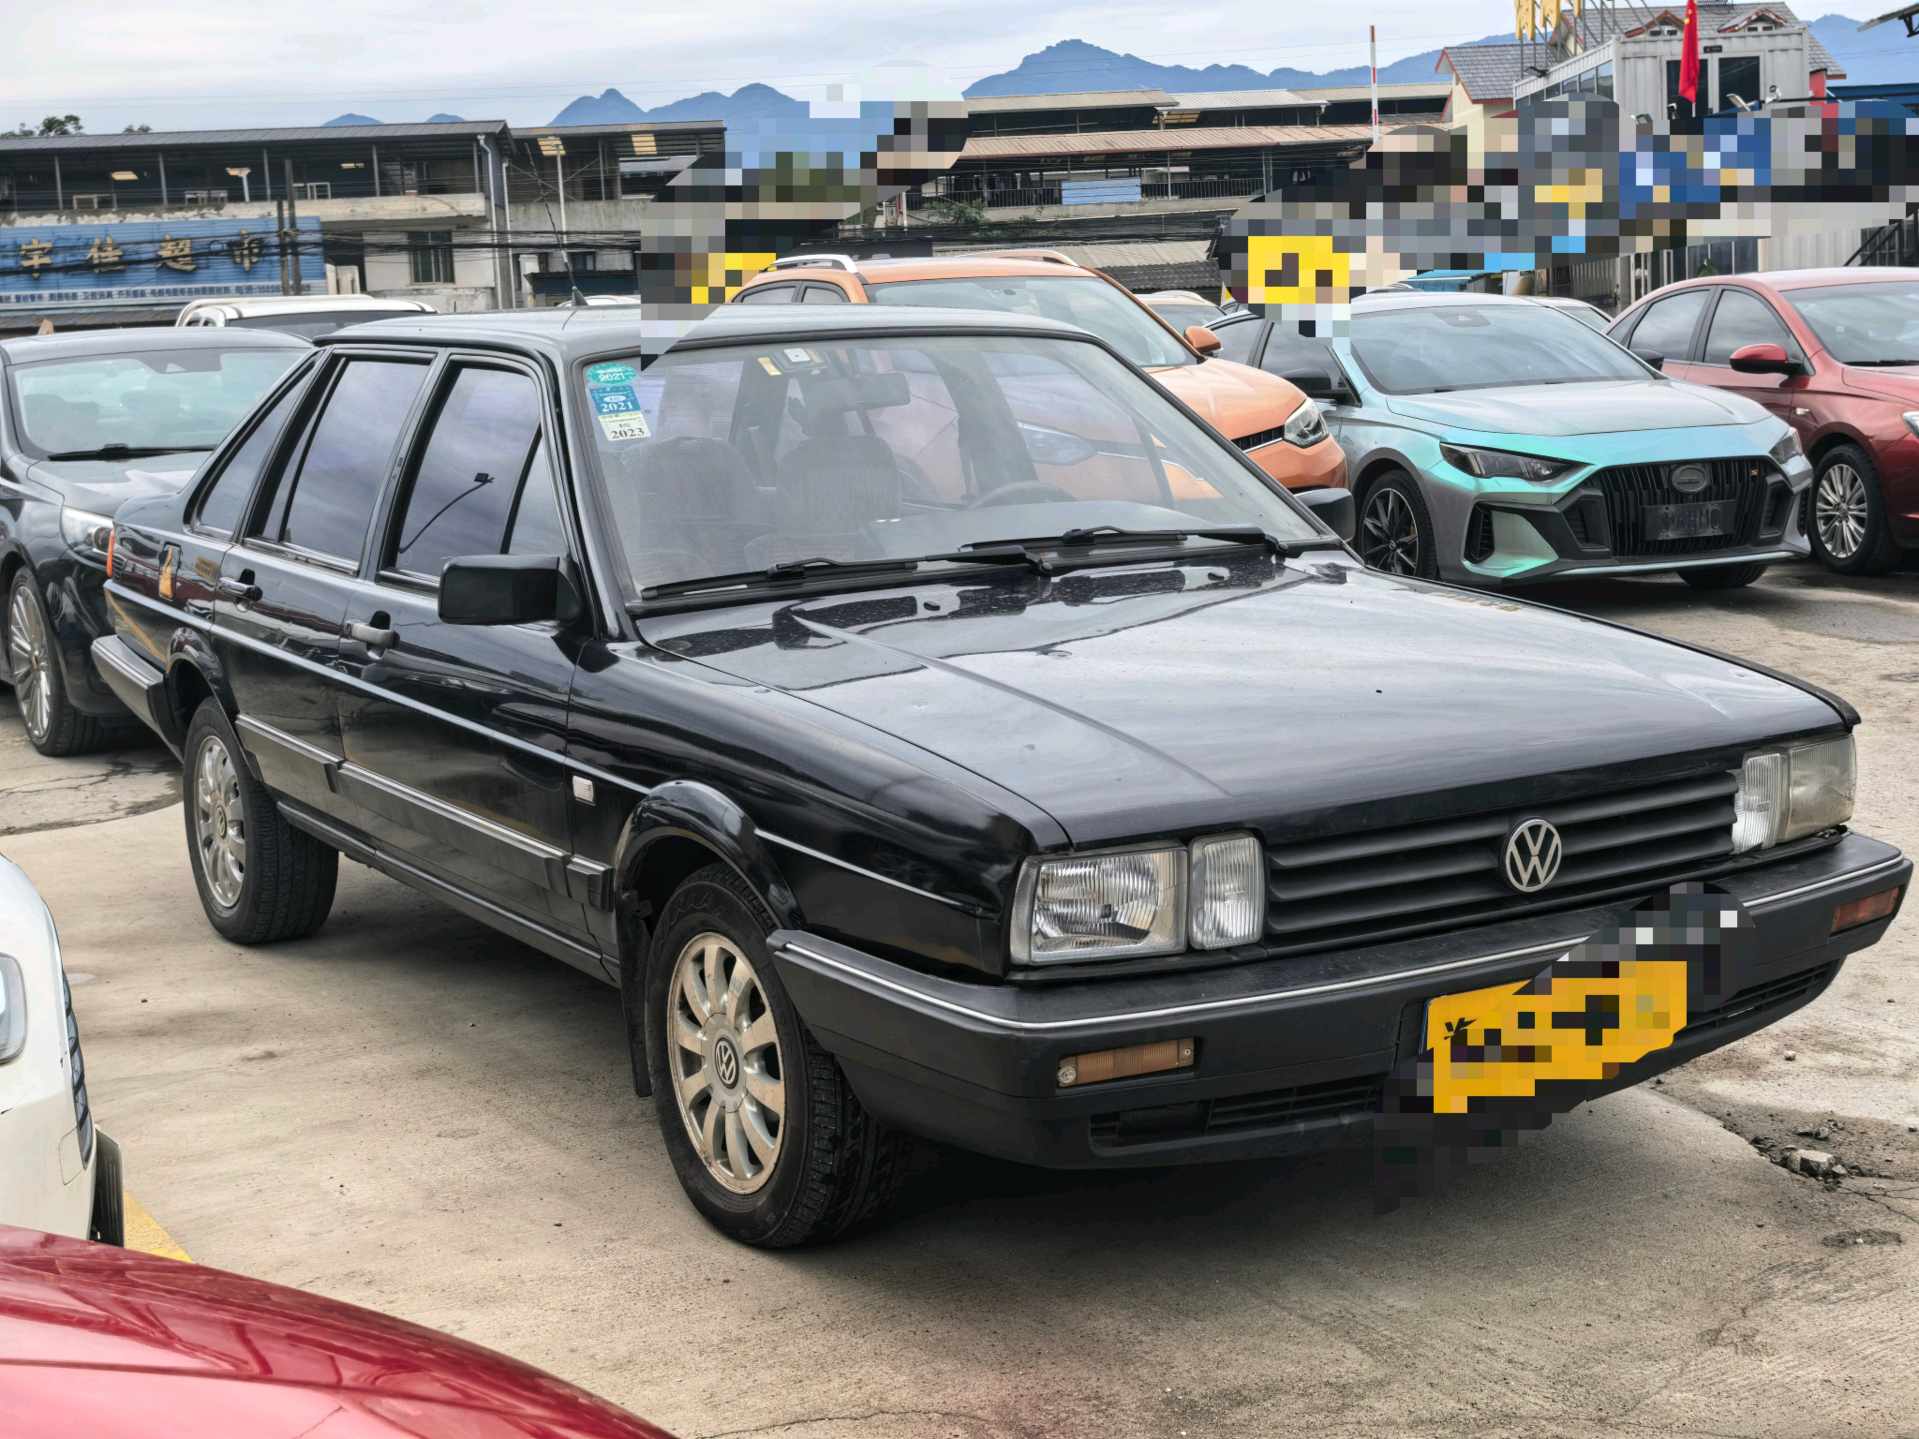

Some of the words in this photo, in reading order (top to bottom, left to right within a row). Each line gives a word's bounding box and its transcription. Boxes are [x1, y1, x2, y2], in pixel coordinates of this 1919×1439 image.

[600, 401, 633, 412] 2021
[610, 427, 645, 439] 2023
[1505, 819, 1562, 892] VW
